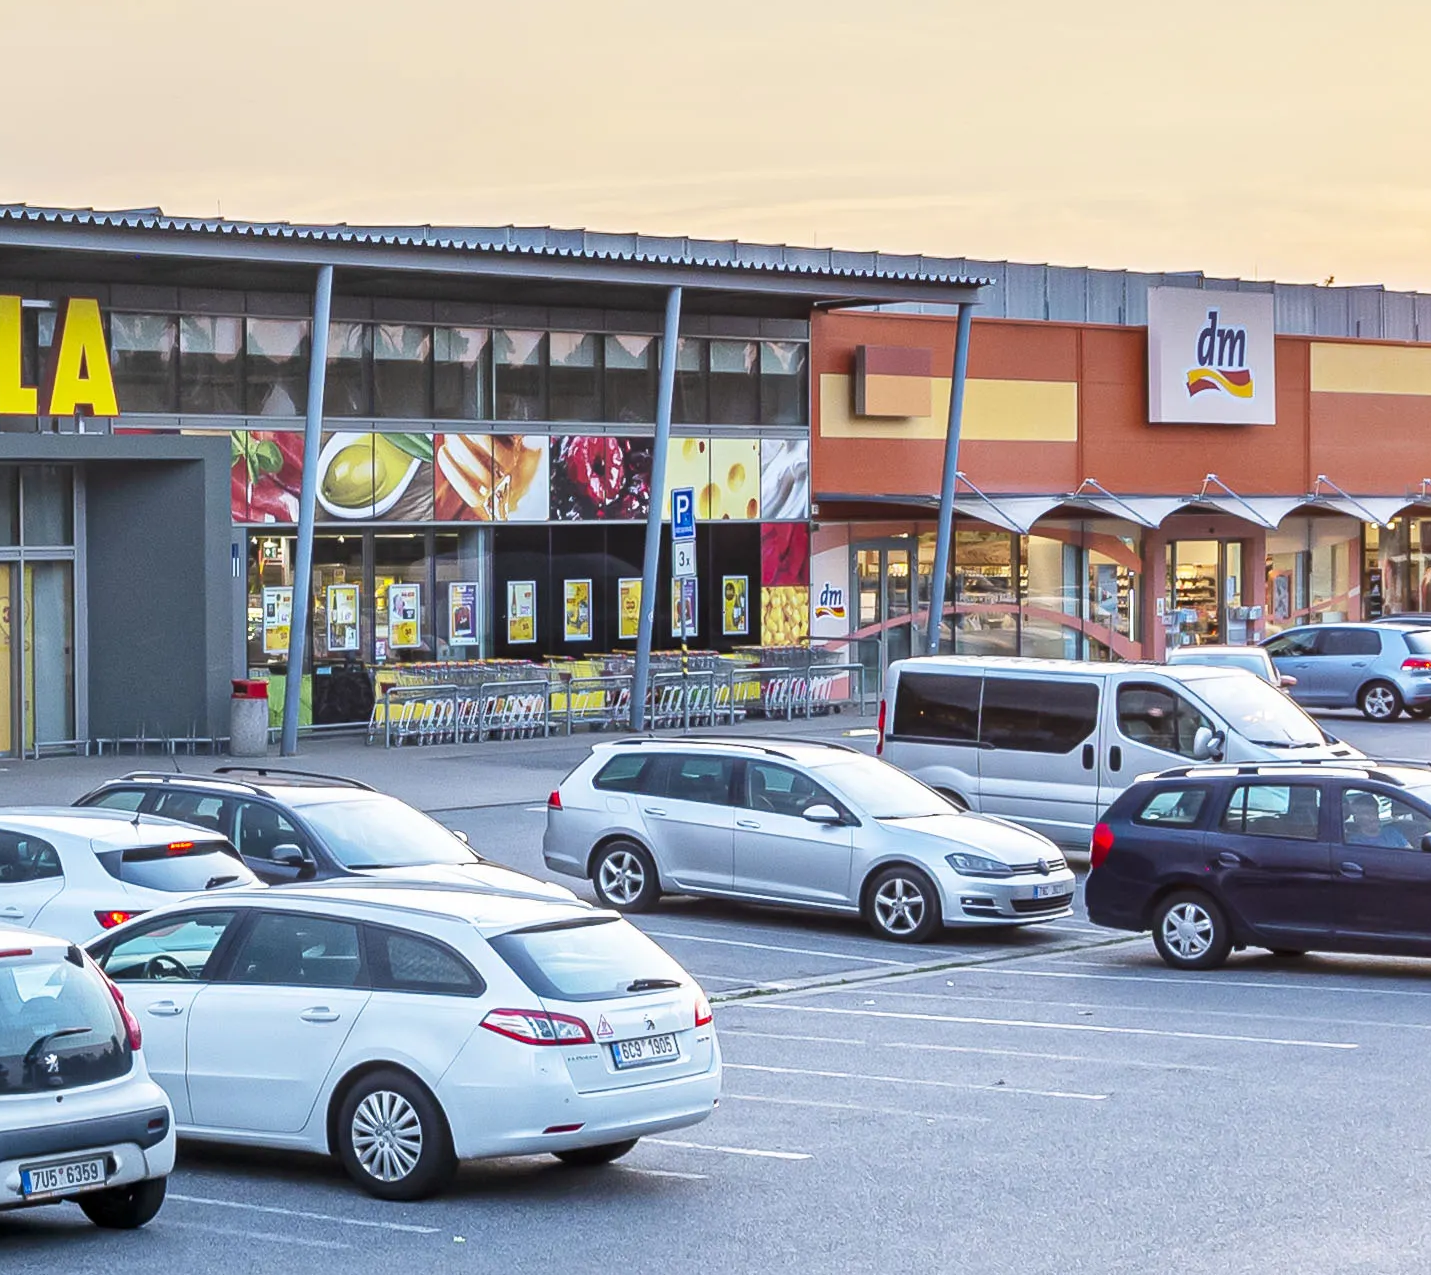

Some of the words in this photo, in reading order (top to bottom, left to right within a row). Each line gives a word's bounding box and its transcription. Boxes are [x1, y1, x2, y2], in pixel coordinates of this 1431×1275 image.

[1196, 310, 1247, 367] dm
[676, 494, 690, 525] P
[820, 582, 842, 606] dm
[621, 1042, 643, 1060] 6C9
[648, 1035, 673, 1055] 1905
[32, 1170, 58, 1190] 7U5
[66, 1162, 98, 1184] 6359
